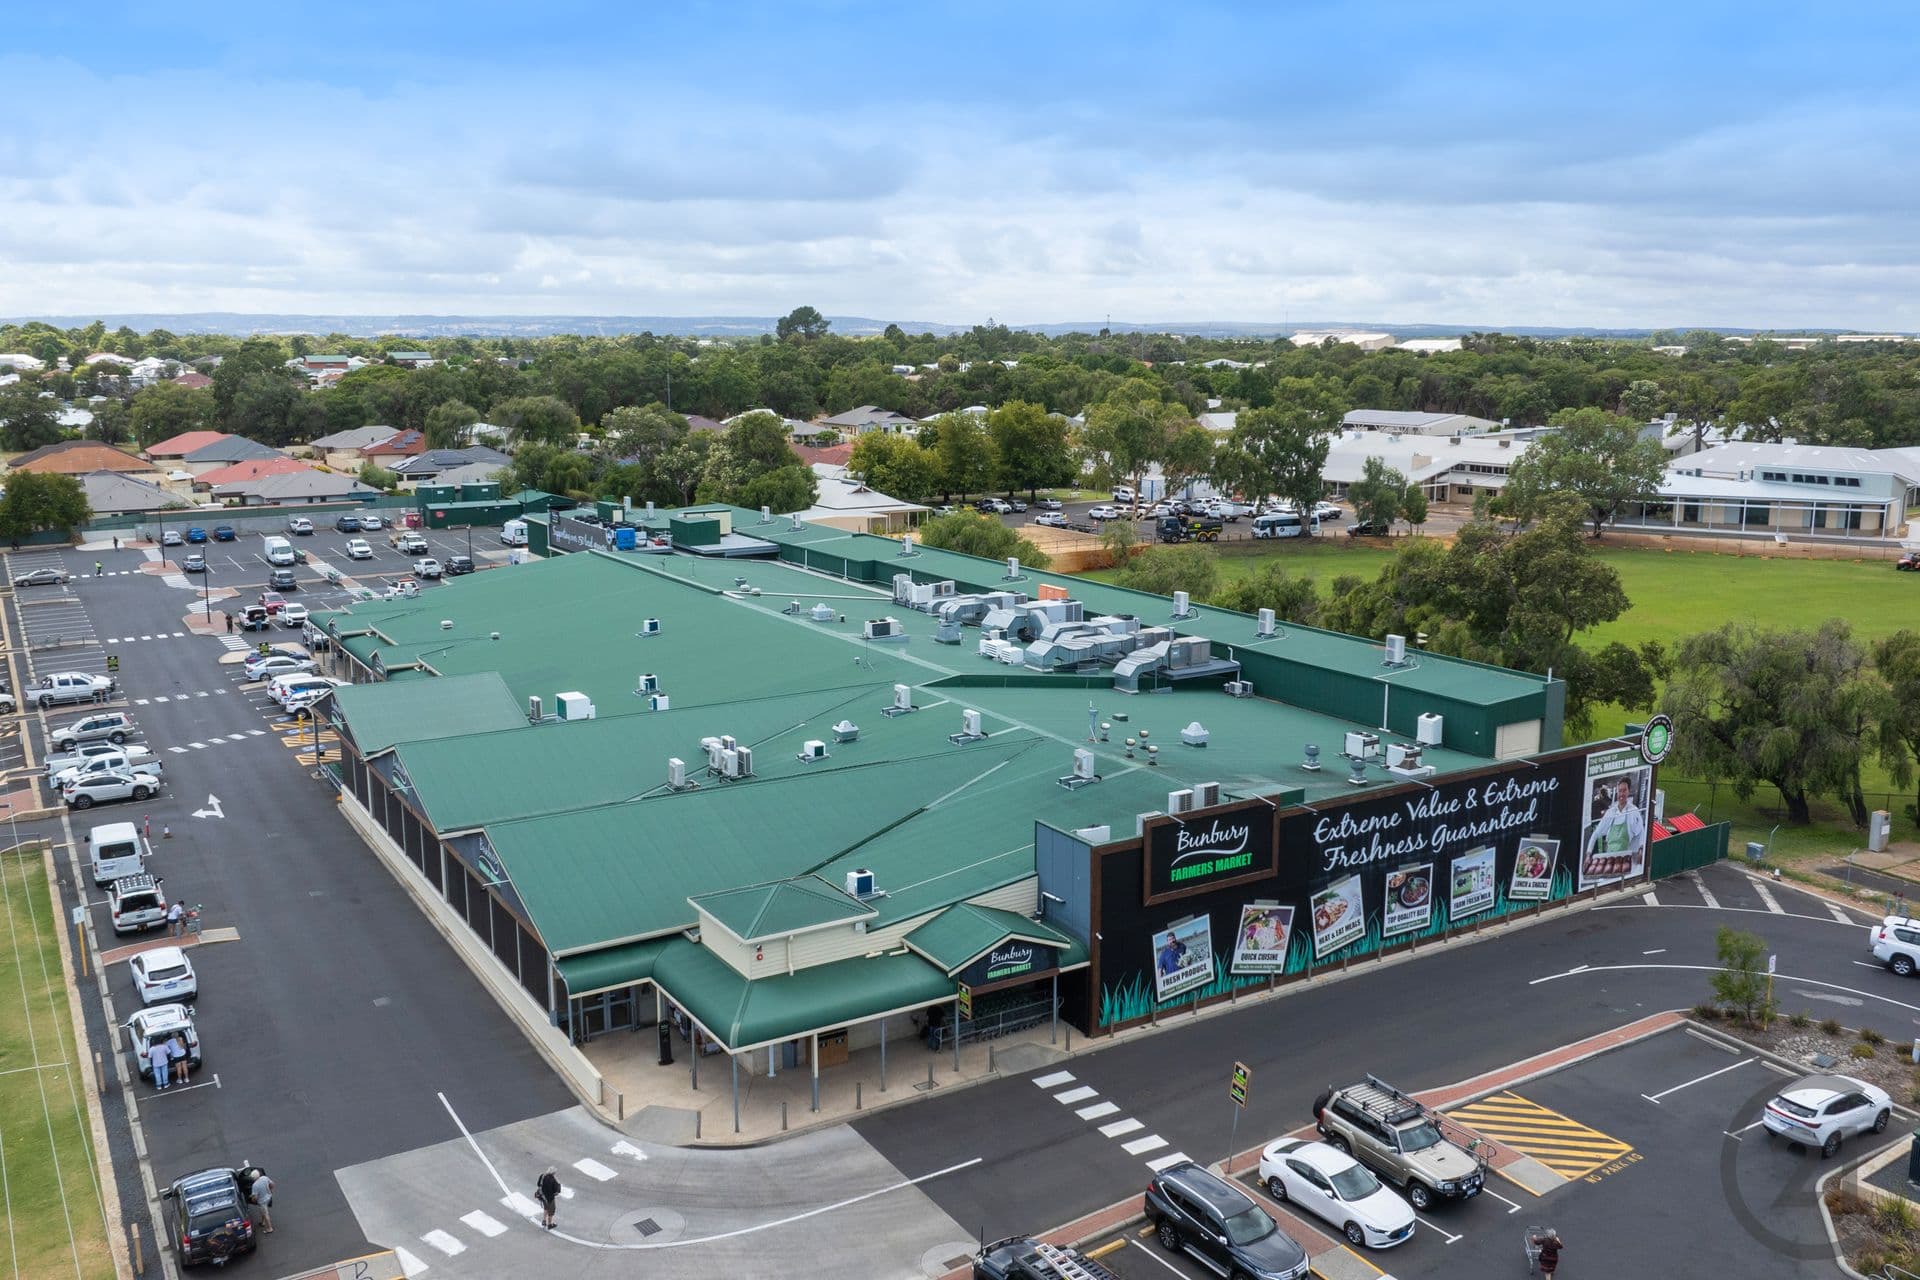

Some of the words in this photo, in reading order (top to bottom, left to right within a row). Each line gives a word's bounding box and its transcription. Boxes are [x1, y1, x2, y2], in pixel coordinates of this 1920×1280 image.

[1603, 759, 1624, 772] MARKET
[1624, 756, 1639, 768] MADE
[1313, 812, 1402, 844] Extreme
[1406, 790, 1461, 821] Value
[1465, 787, 1478, 810] &
[1483, 777, 1559, 806] Extreme
[1175, 820, 1249, 857] Bunbury
[1323, 832, 1429, 871] Freshness
[1431, 798, 1538, 853] Guaranteed
[1171, 861, 1214, 882] FARMERS
[1215, 853, 1253, 872] MARKET
[1454, 901, 1466, 909] FARM
[1466, 896, 1480, 904] FRESH
[1480, 891, 1491, 900] MILK
[1387, 915, 1397, 924] TOP
[1397, 910, 1416, 922] QUALITY
[1416, 907, 1428, 917] BEEF
[1318, 934, 1331, 945] HEAT
[1335, 926, 1345, 937] EAT
[1344, 919, 1361, 932] MEALS
[990, 946, 1033, 965] Bunbury
[1240, 952, 1257, 962] QUICK
[1257, 952, 1278, 961] CUISINE
[986, 968, 1011, 979] FARMERS
[1011, 963, 1032, 974] MARKET
[1162, 972, 1181, 988] FRESH
[1181, 963, 1208, 980] PRODUCE
[1584, 1174, 1603, 1184] NO
